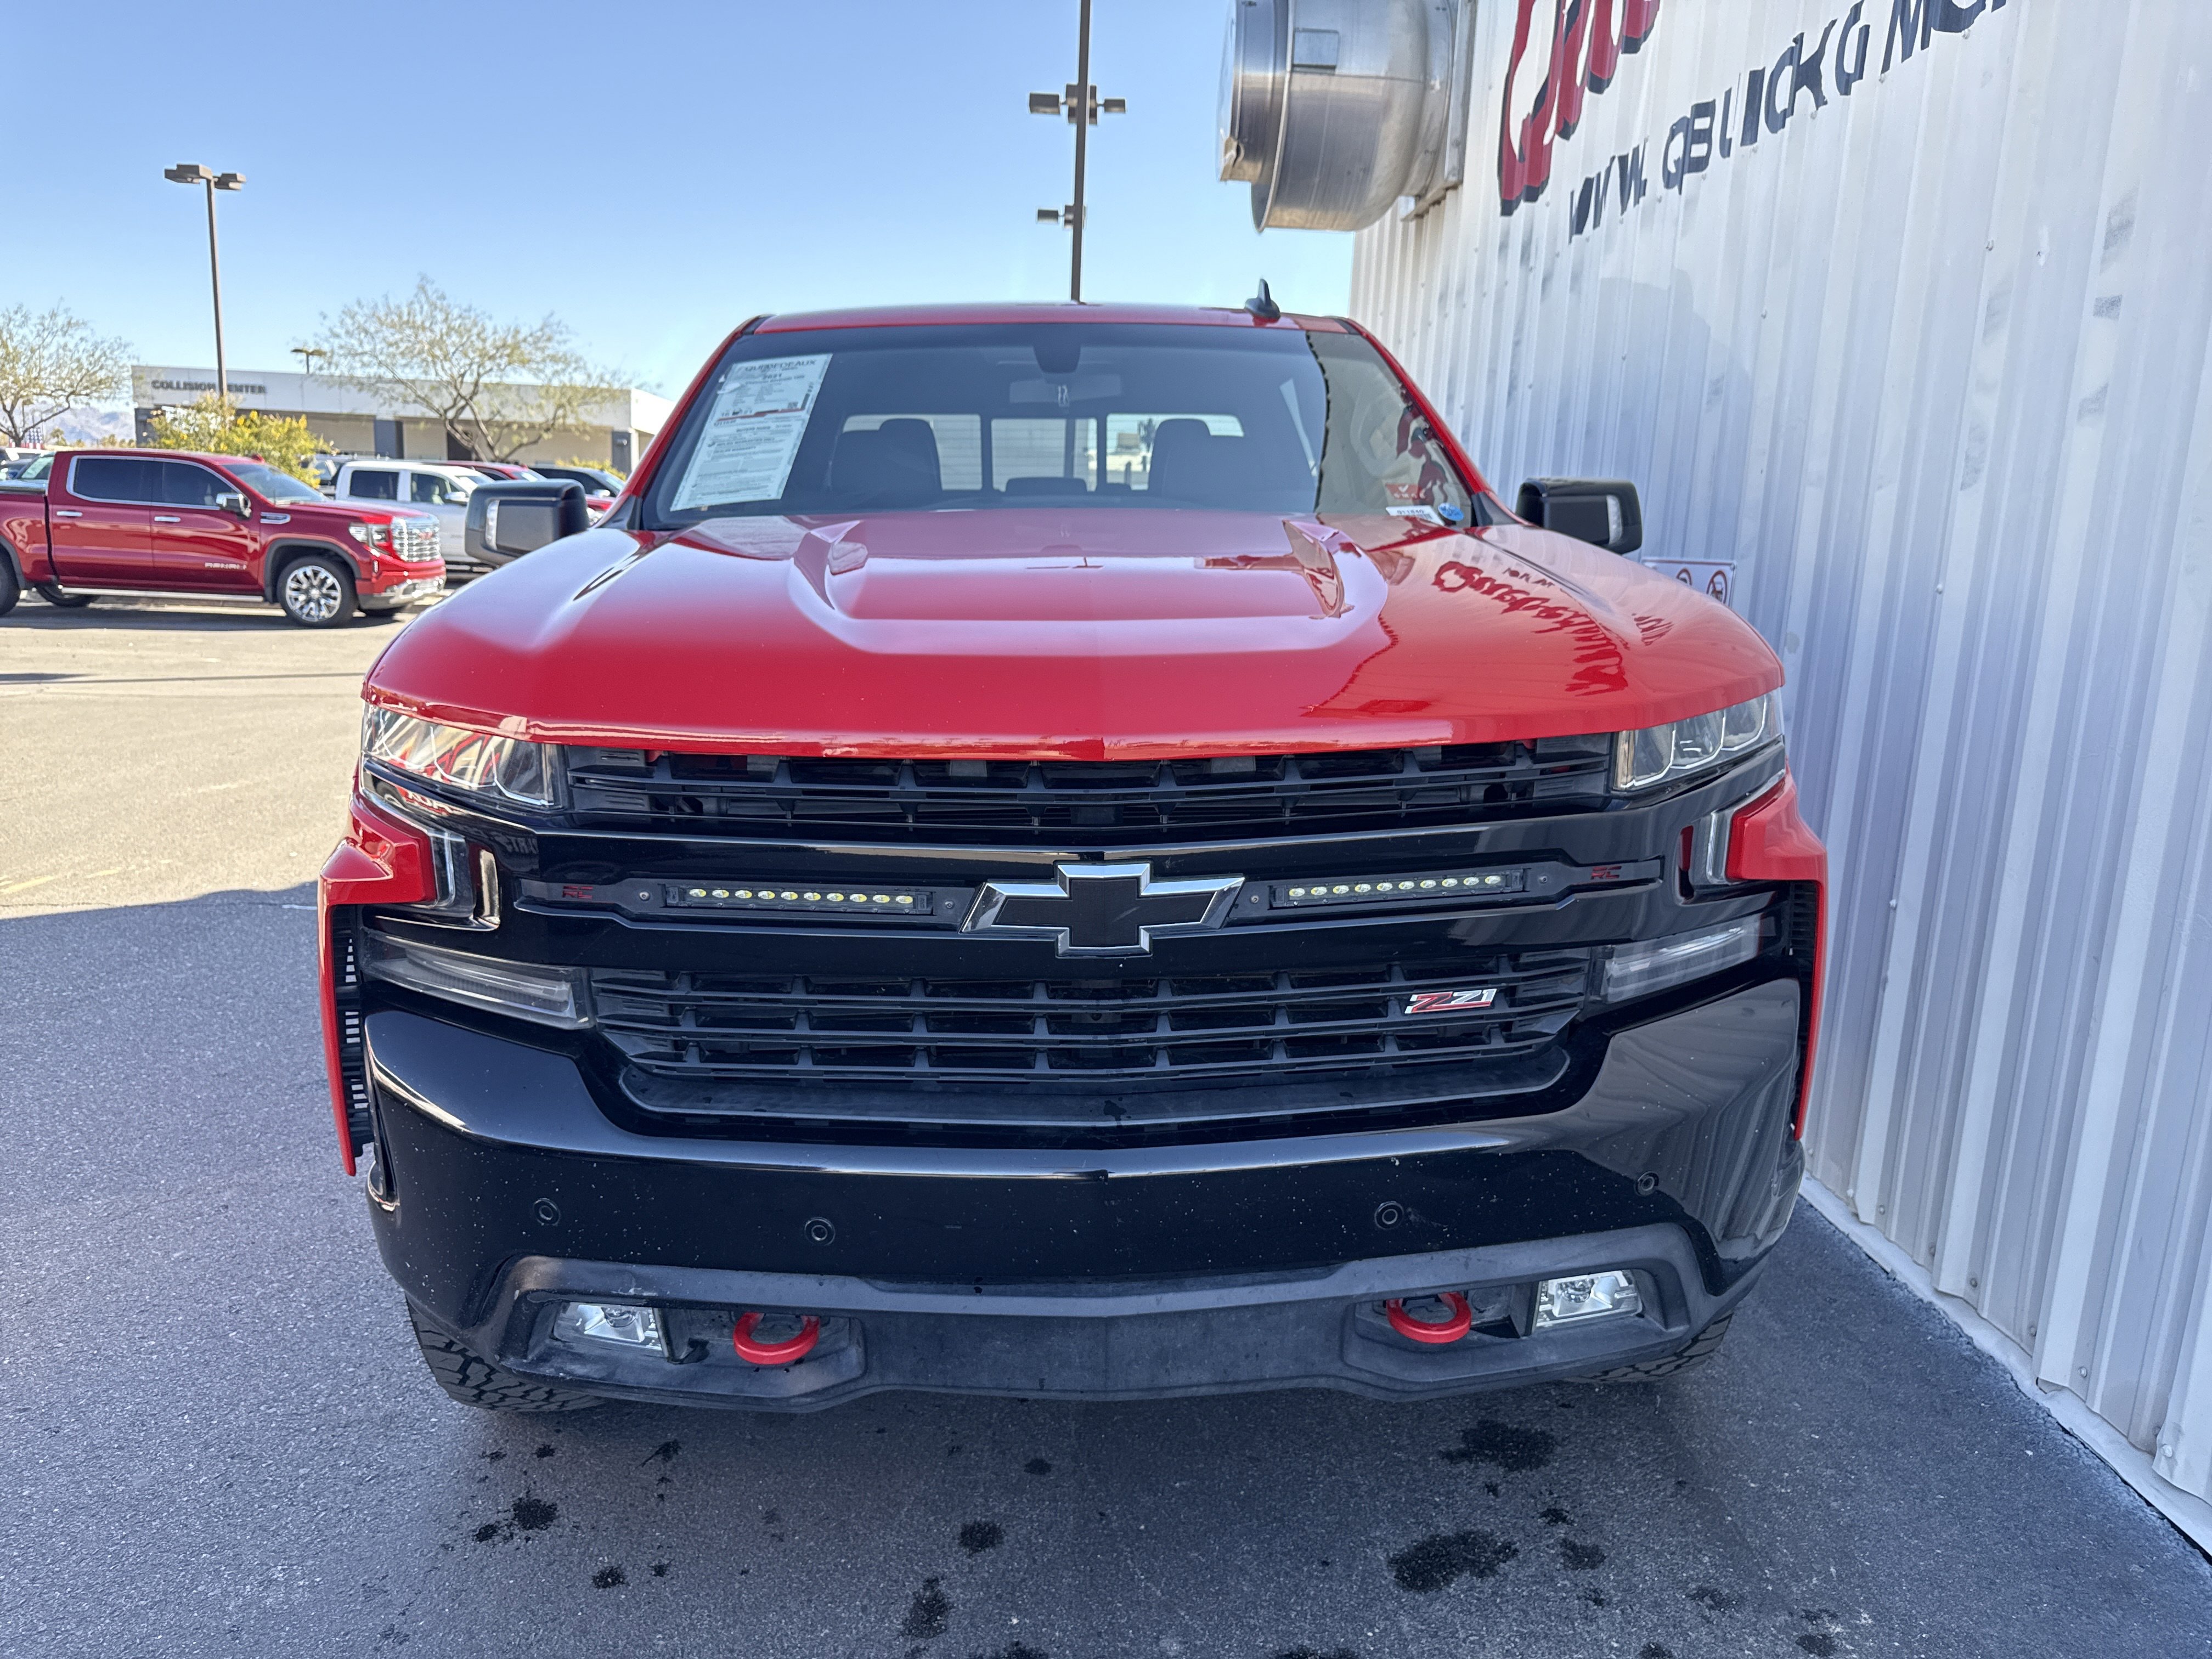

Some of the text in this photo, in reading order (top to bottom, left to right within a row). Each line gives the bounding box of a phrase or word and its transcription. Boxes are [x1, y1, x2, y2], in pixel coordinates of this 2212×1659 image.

[151, 380, 267, 394] COLLISION ENTER
[1404, 988, 1497, 1014] Z71
